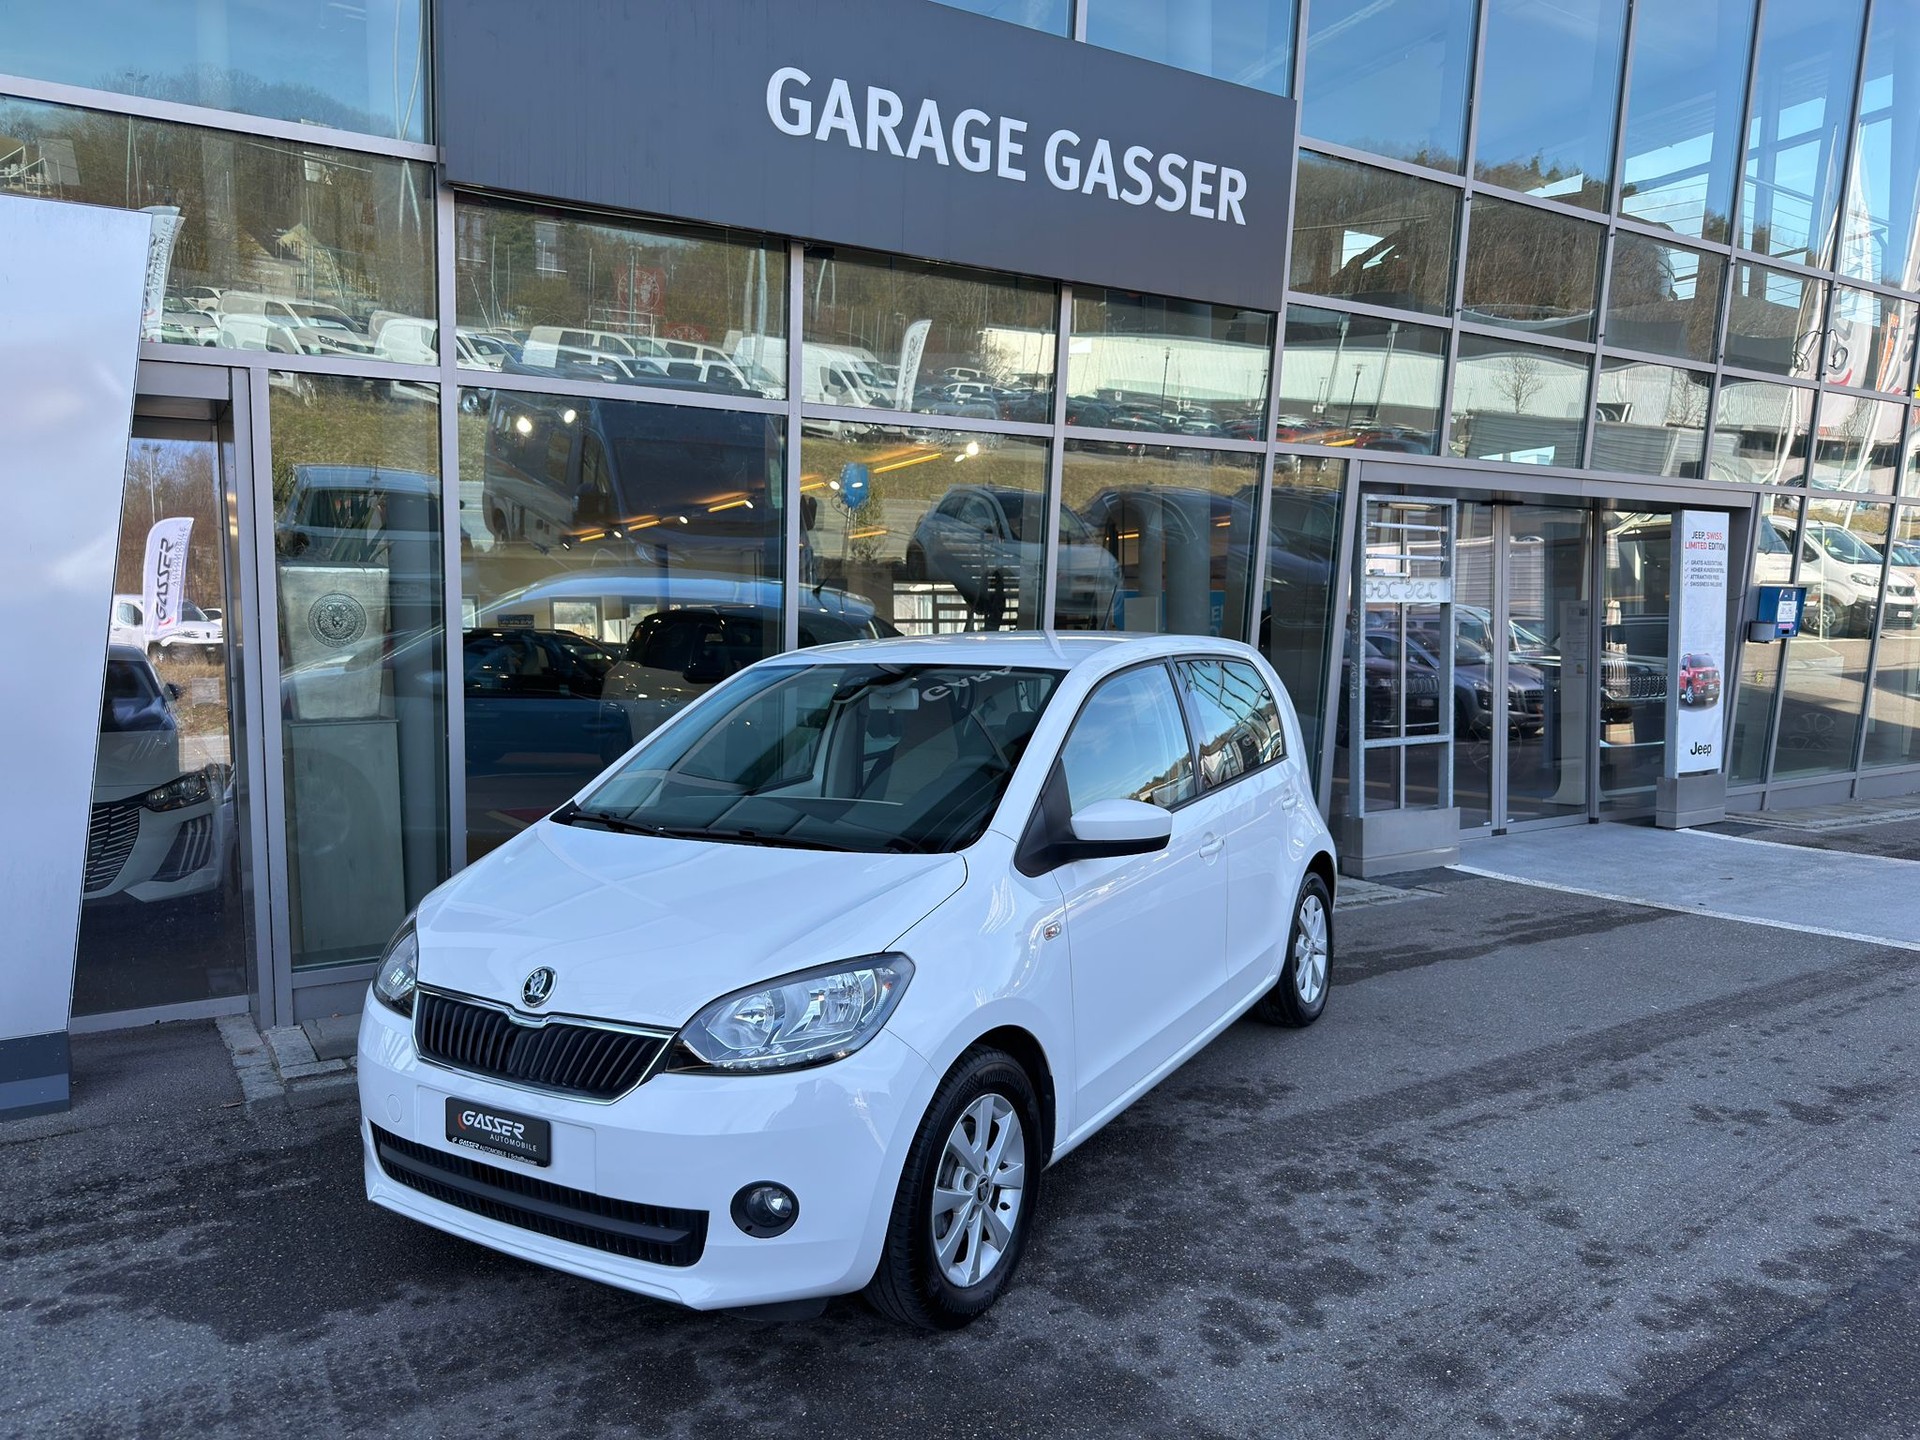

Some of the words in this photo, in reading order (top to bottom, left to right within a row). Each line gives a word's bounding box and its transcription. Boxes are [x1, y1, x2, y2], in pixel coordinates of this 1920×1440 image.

[766, 66, 1028, 183] GARAGE
[1044, 129, 1248, 226] GASSER
[1685, 541, 1707, 550] LIMITED
[1706, 532, 1723, 540] SWISS
[155, 537, 175, 620] GASSER
[1690, 741, 1712, 756] Jeep
[462, 1110, 525, 1140] GASSER
[489, 1133, 538, 1152] AUTOMOBILE
